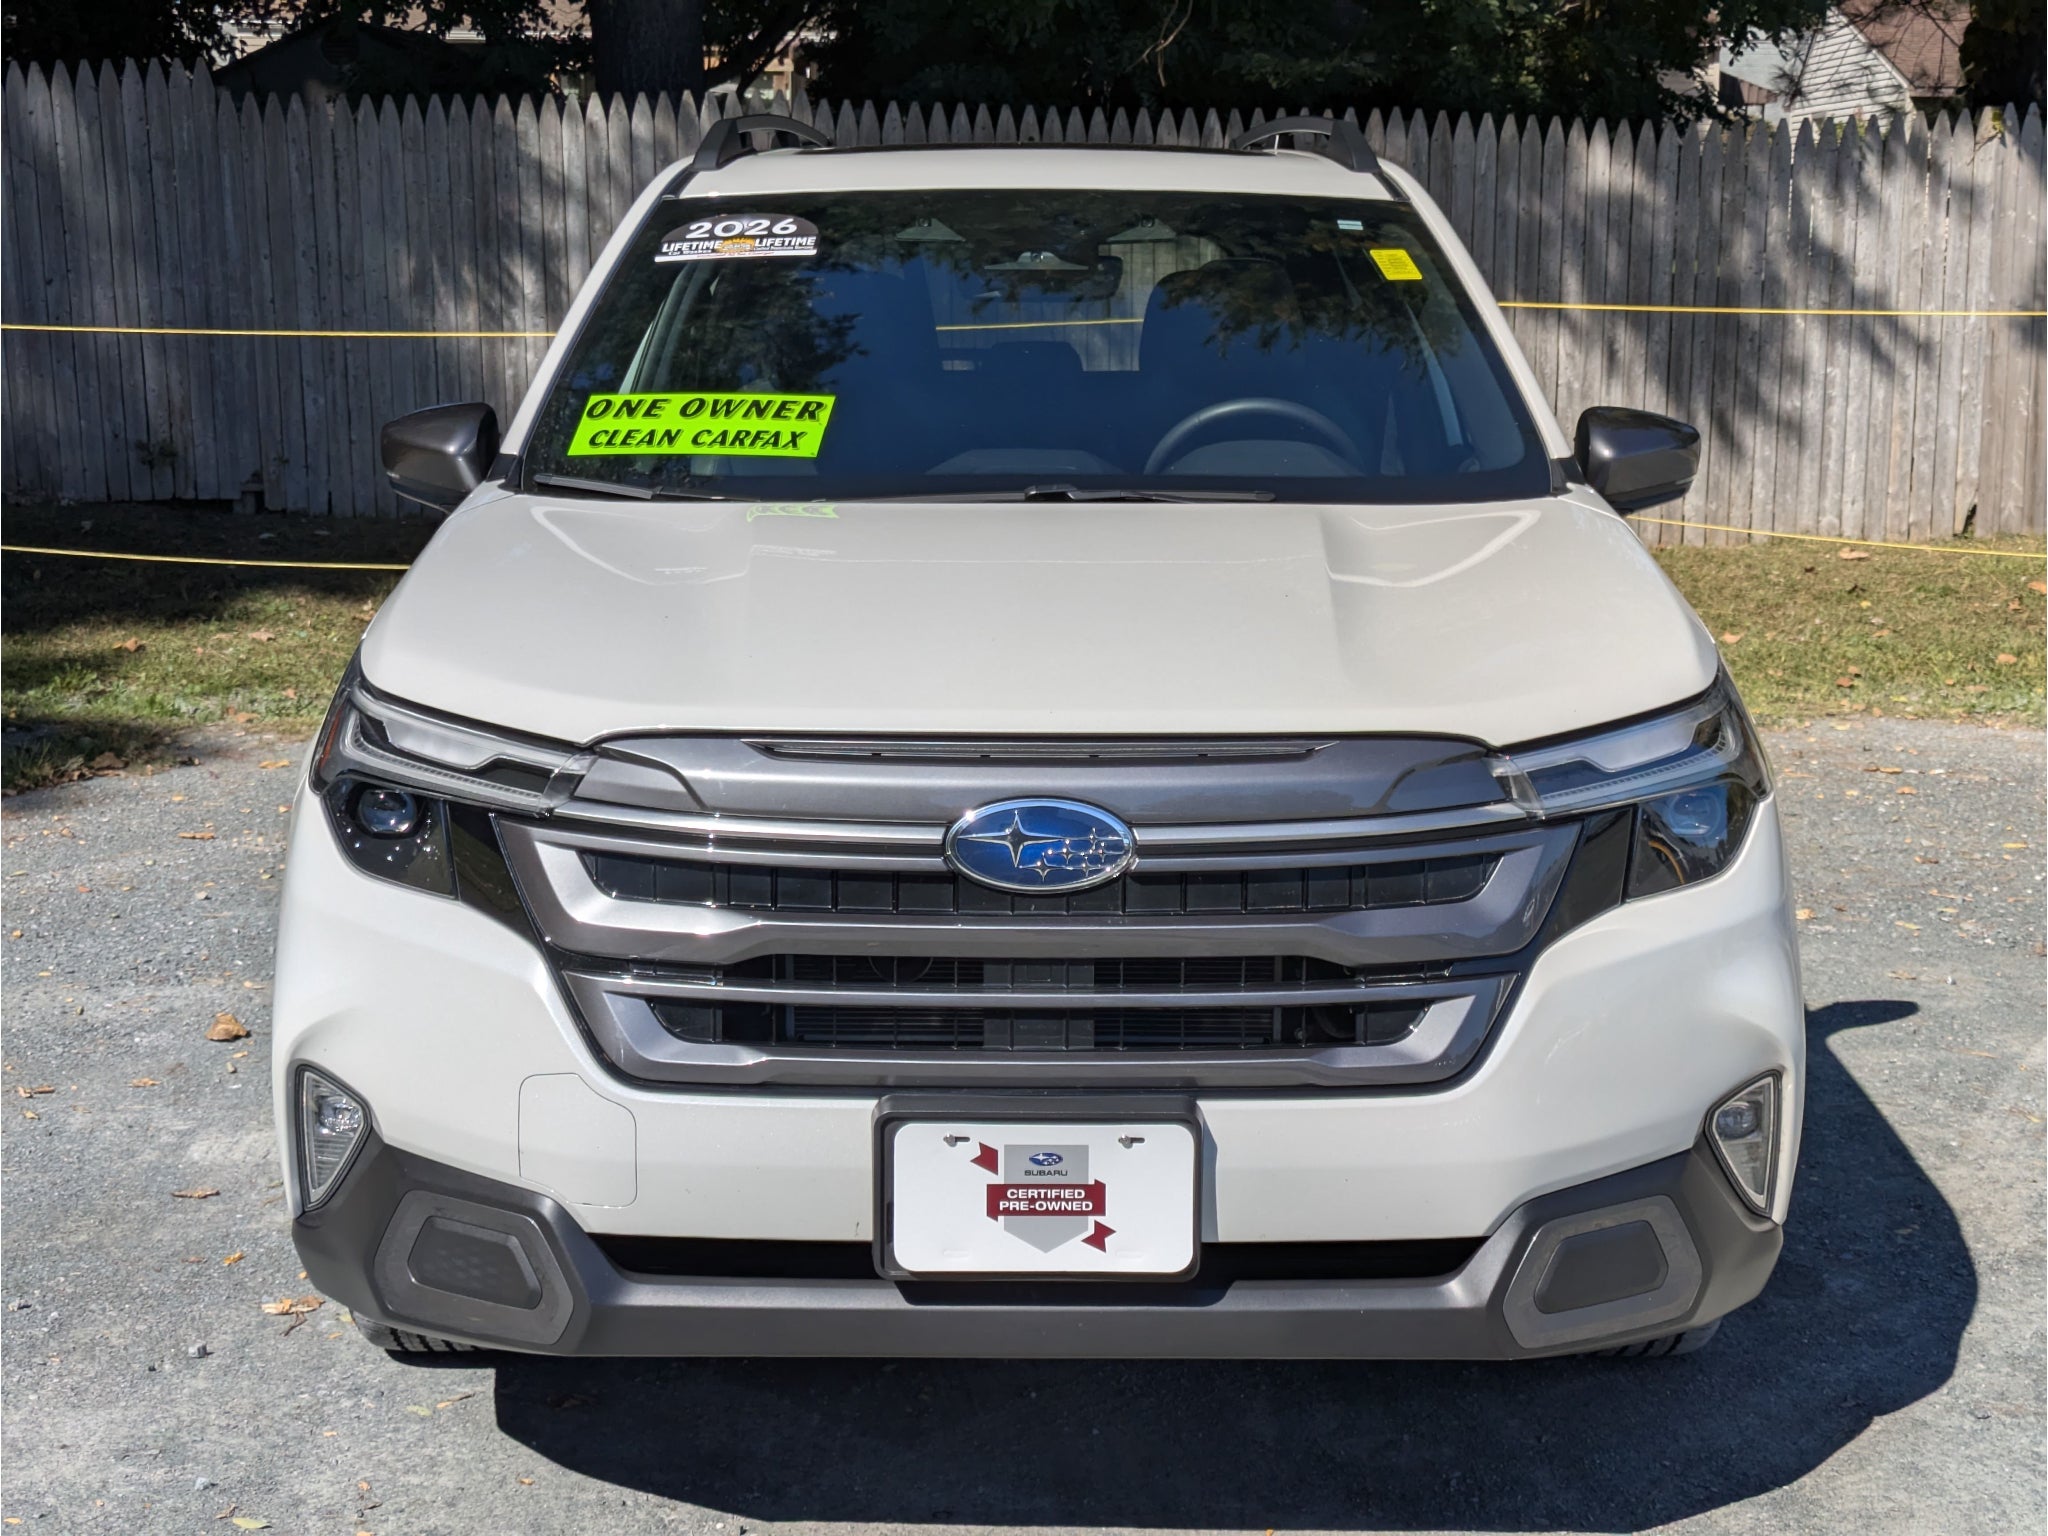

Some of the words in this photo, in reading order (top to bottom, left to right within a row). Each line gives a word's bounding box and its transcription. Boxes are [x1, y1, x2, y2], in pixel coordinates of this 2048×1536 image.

[685, 218, 798, 239] 2026
[662, 239, 724, 253] LIFETIME
[754, 236, 817, 248] LIFETIME
[586, 398, 672, 420] ONE
[679, 397, 827, 421] OWNER
[588, 428, 683, 448] CLEAN
[691, 429, 808, 450] CARFAX
[1024, 1169, 1068, 1177] SUBARU
[1006, 1188, 1086, 1200] CERTIFIED
[999, 1201, 1093, 1211] PRE-OWNED
